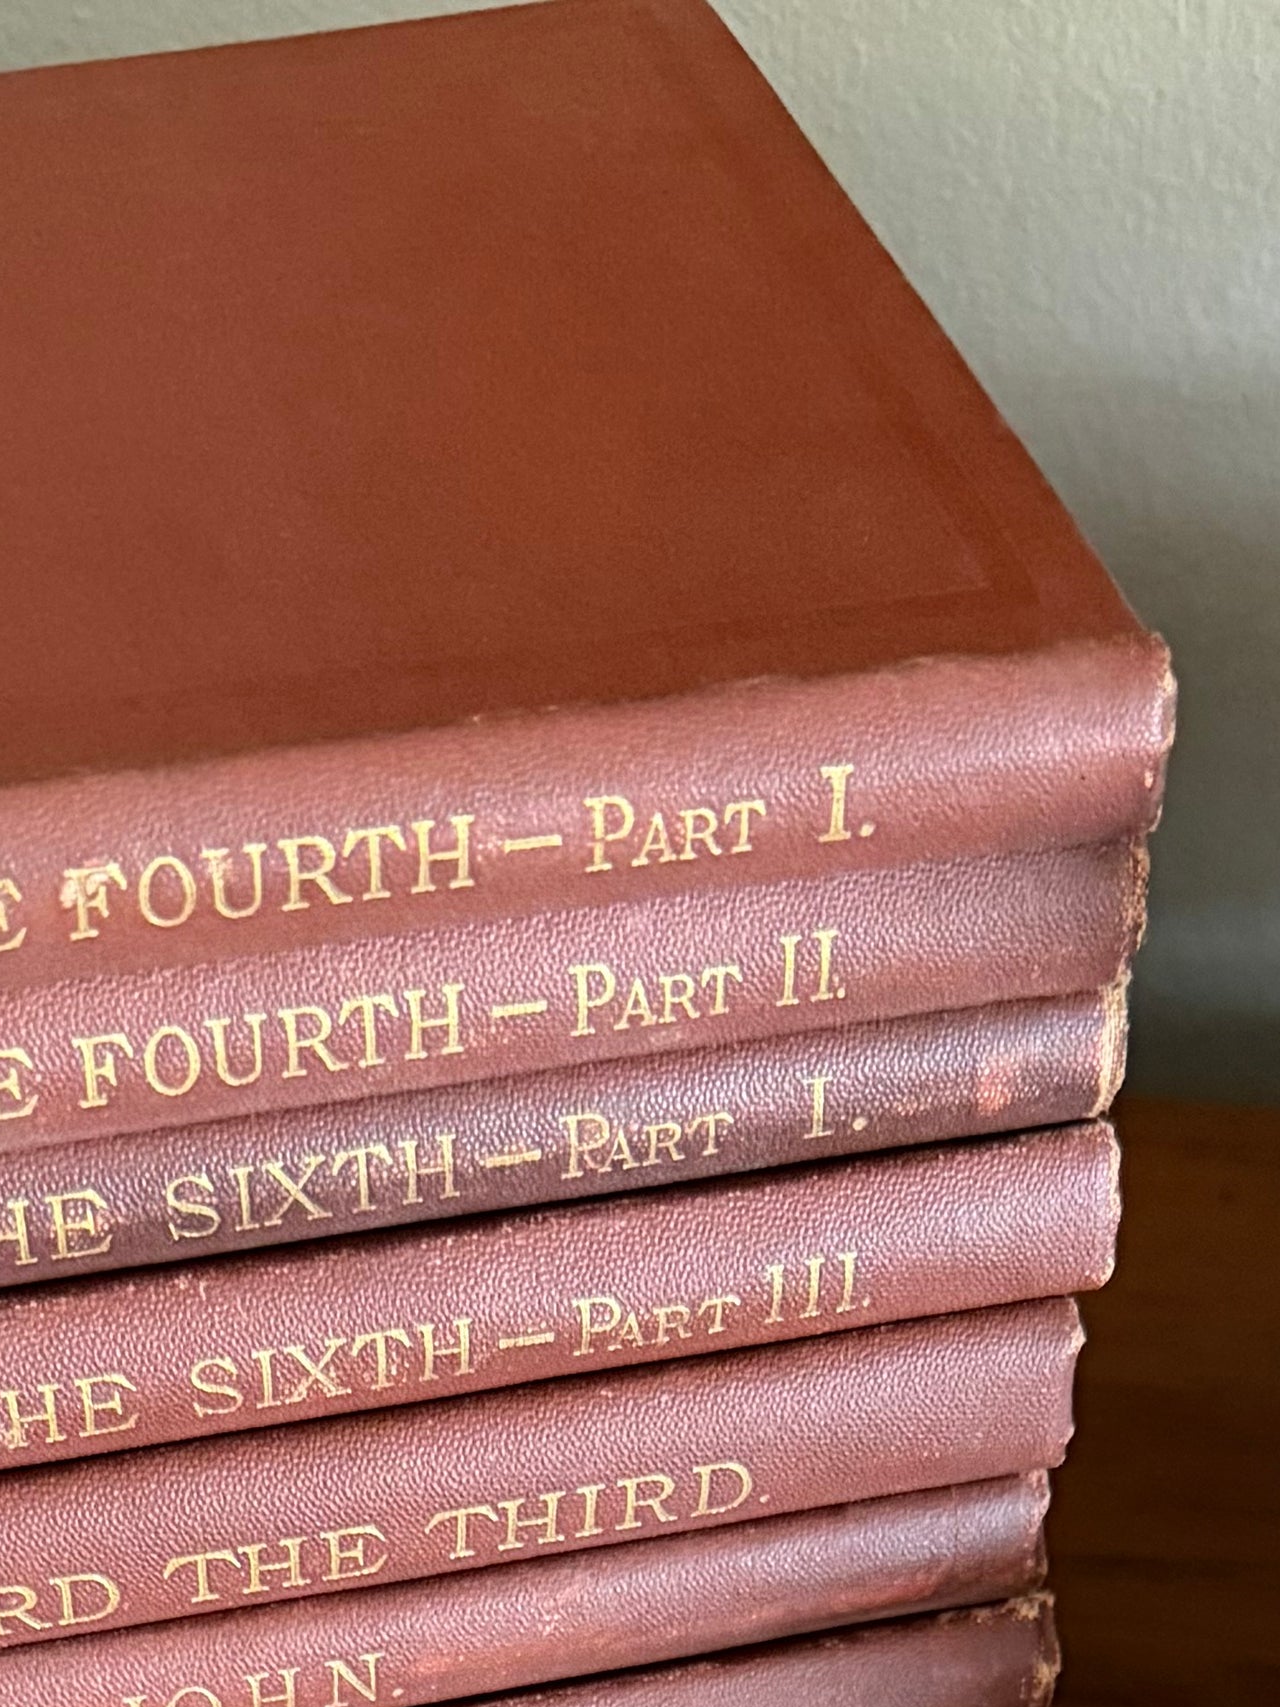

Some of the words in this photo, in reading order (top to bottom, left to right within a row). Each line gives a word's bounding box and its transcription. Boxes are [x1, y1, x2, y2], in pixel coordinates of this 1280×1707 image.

[820, 764, 875, 842] I.
[775, 930, 846, 1007] II.
[803, 1076, 867, 1139] I.
[764, 1251, 870, 1323] III.
[164, 1526, 387, 1603] THE
[426, 1461, 771, 1560] THIRD.
